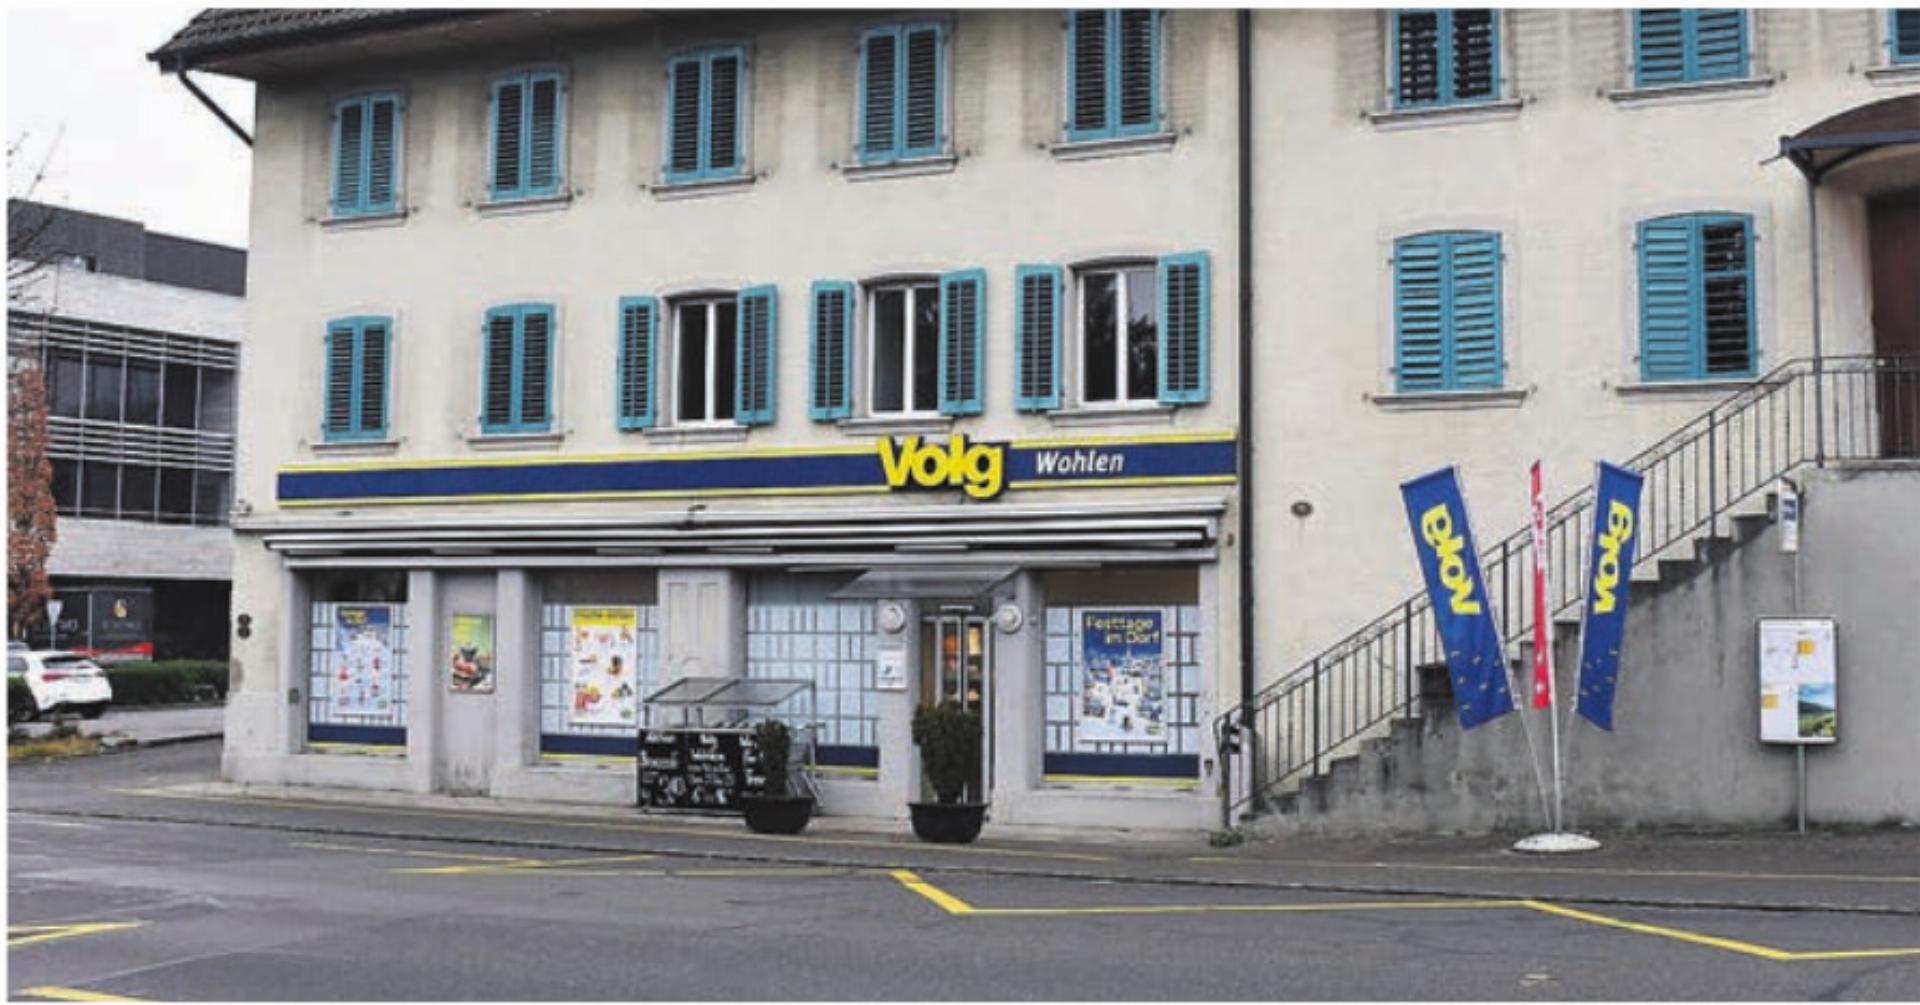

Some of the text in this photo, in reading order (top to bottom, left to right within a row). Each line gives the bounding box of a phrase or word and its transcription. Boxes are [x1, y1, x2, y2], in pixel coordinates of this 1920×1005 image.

[877, 434, 1125, 498] Volg Wohlen
[1594, 500, 1633, 614] Volg
[1086, 616, 1153, 632] Festtage
[1126, 630, 1160, 644] Dorf
